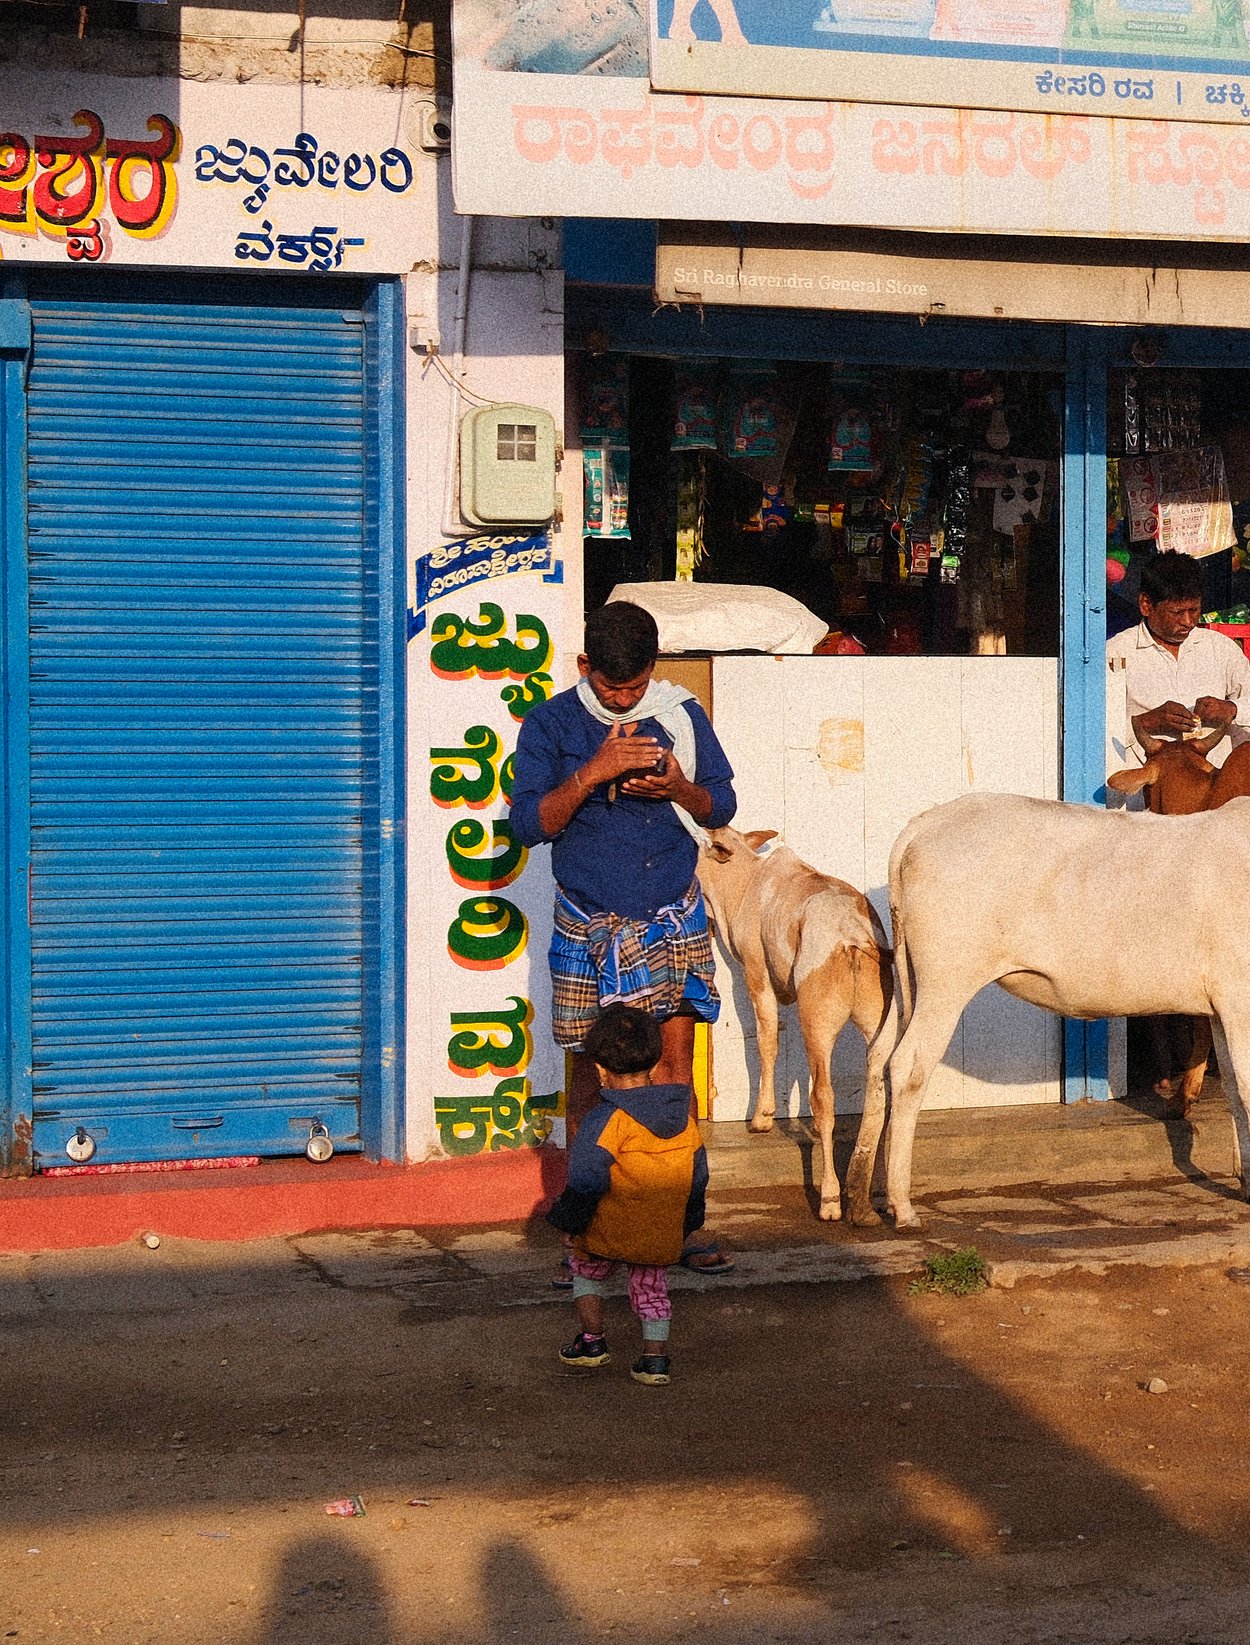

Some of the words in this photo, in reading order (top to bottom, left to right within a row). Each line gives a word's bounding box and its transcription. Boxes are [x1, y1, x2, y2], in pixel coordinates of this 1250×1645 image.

[1035, 69, 1106, 97] ಕೇಸರಿ
[1113, 78, 1154, 101] ರವ
[511, 95, 837, 200] ರಾಘವೇಂದ್ರ
[871, 108, 1092, 180] ಜನರಲ್
[194, 132, 414, 215] ಜ್ಯುವೇಲರಿ
[673, 266, 698, 285] Sri
[703, 268, 813, 290] Raghavendra
[818, 274, 881, 293] General
[886, 277, 928, 297] Store
[428, 545, 462, 568] ಶ್ರೀ
